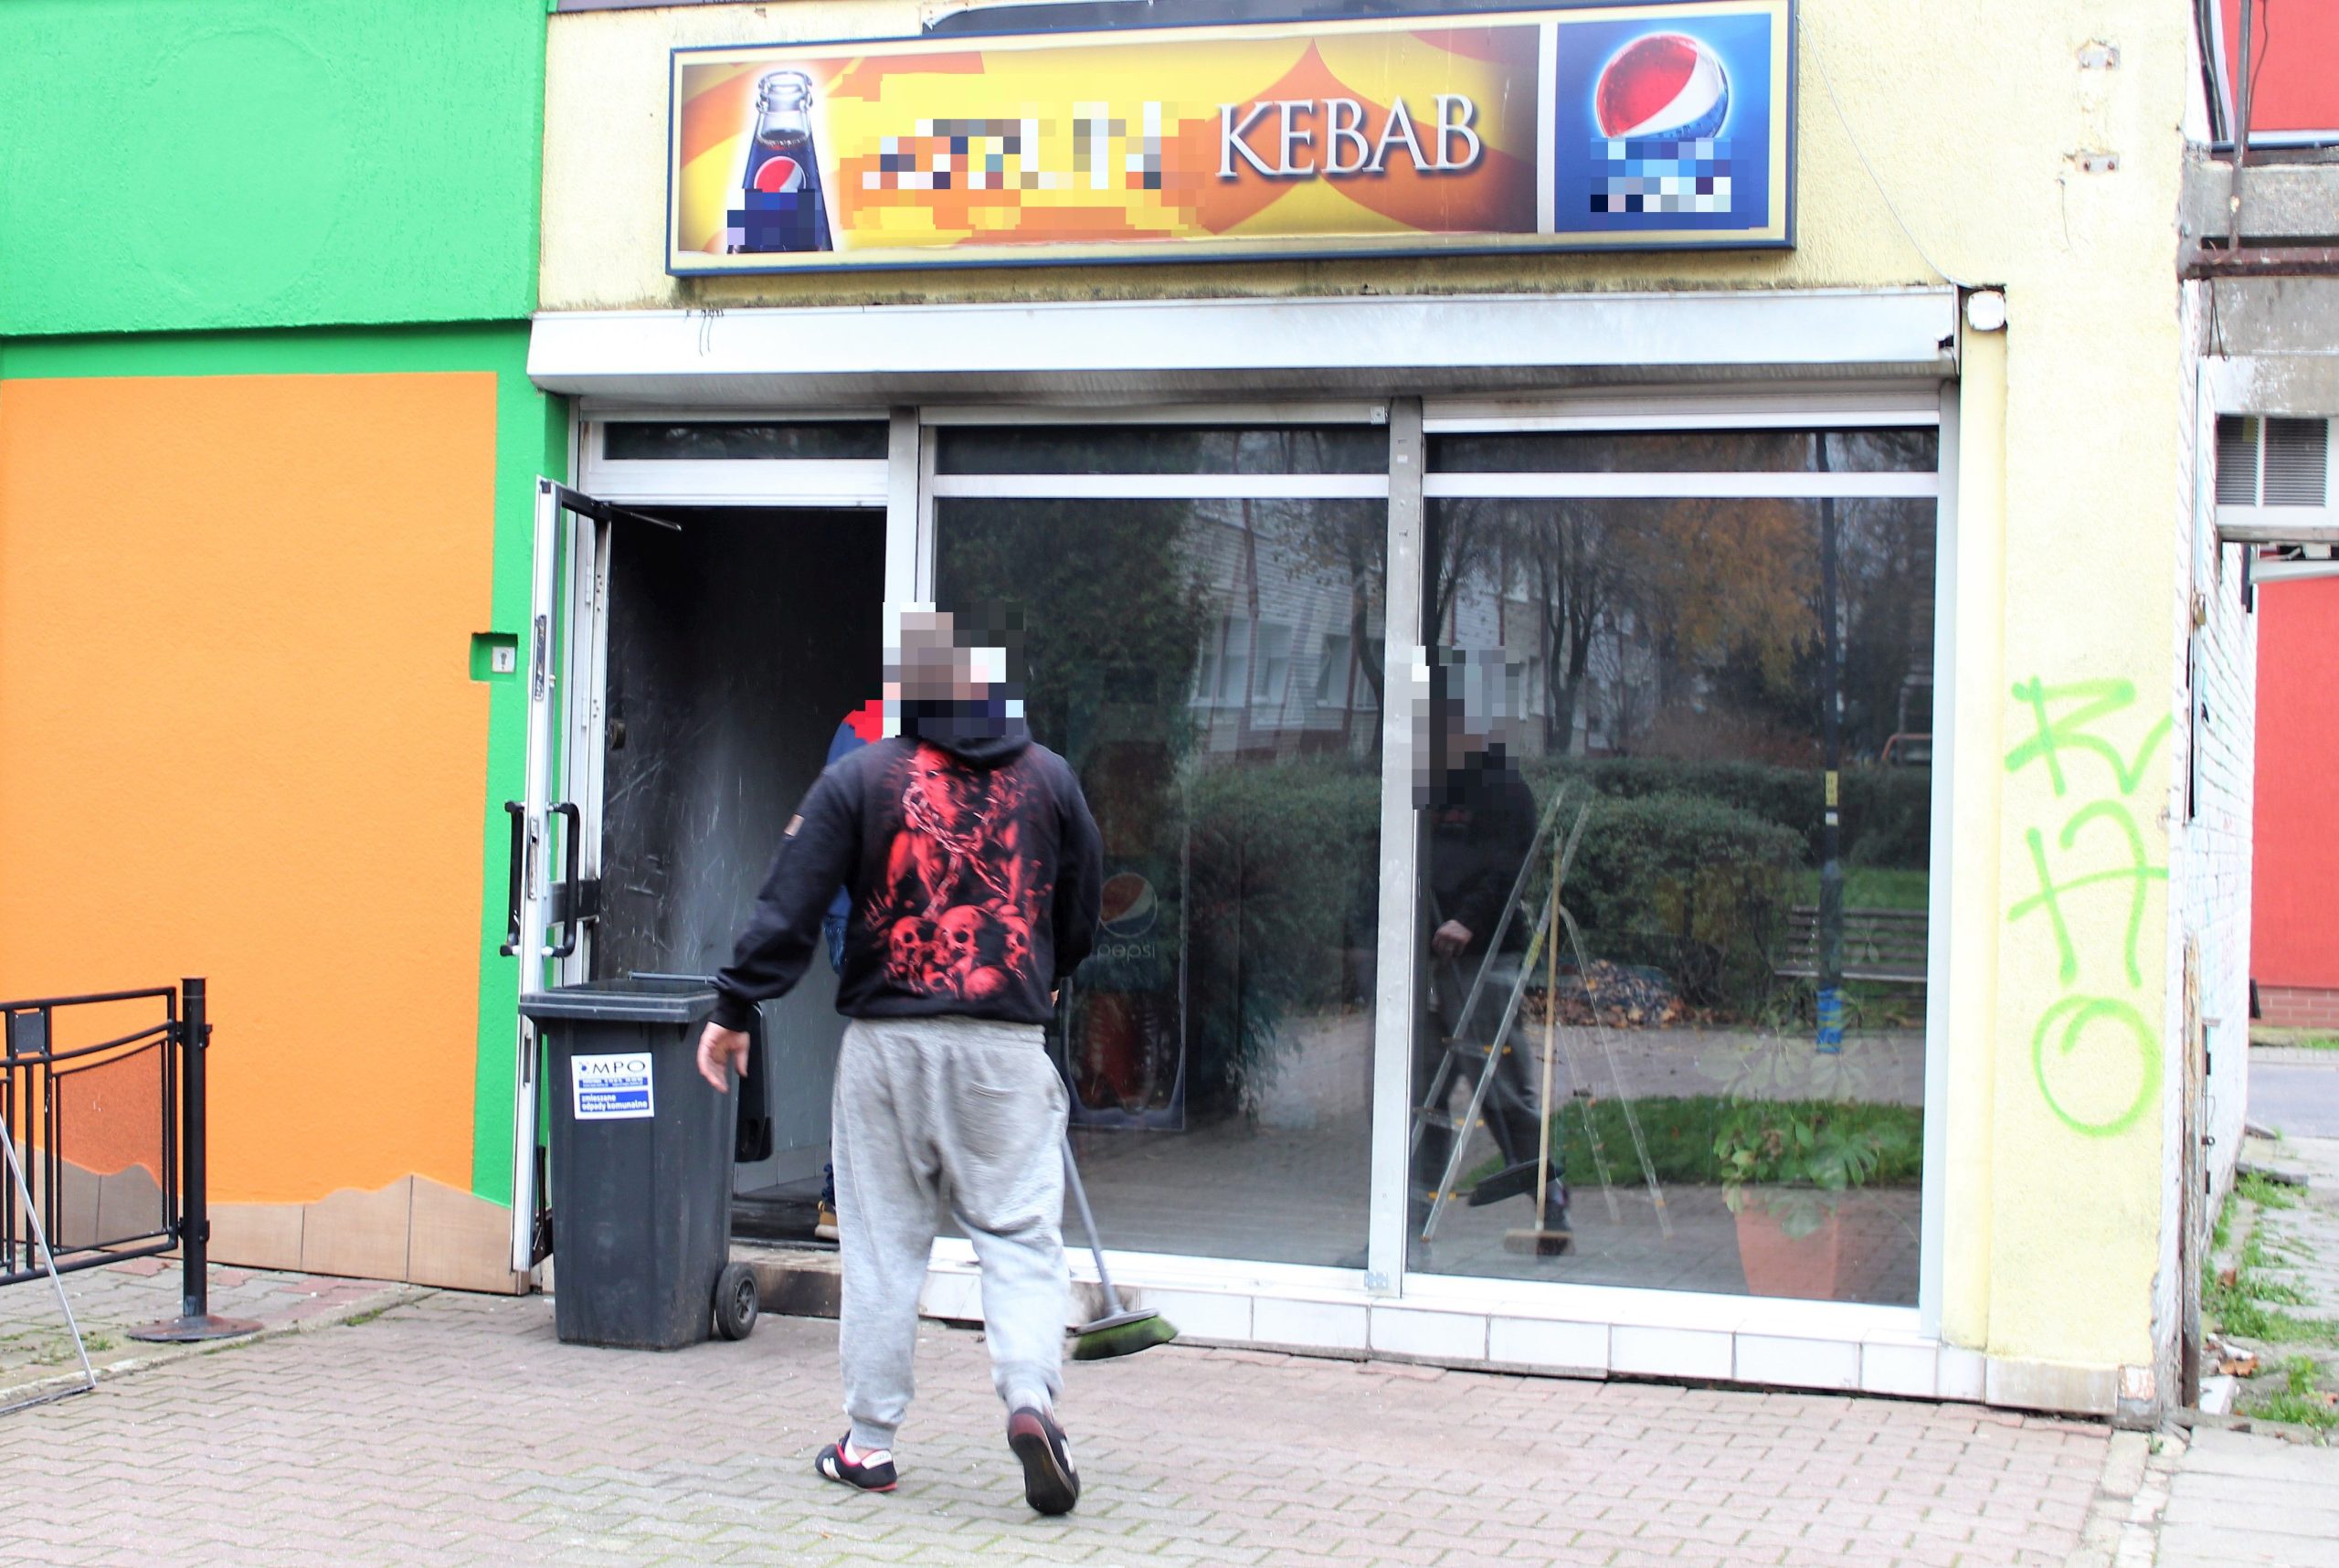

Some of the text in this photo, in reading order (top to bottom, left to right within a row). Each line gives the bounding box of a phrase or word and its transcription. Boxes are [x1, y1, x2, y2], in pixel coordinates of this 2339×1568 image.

[1215, 93, 1480, 177] KEBAB
[1096, 943, 1156, 963] pepsi
[592, 1060, 646, 1075] MPO
[581, 1094, 617, 1104] zmieszane
[582, 1099, 648, 1112] odpady komunalne
